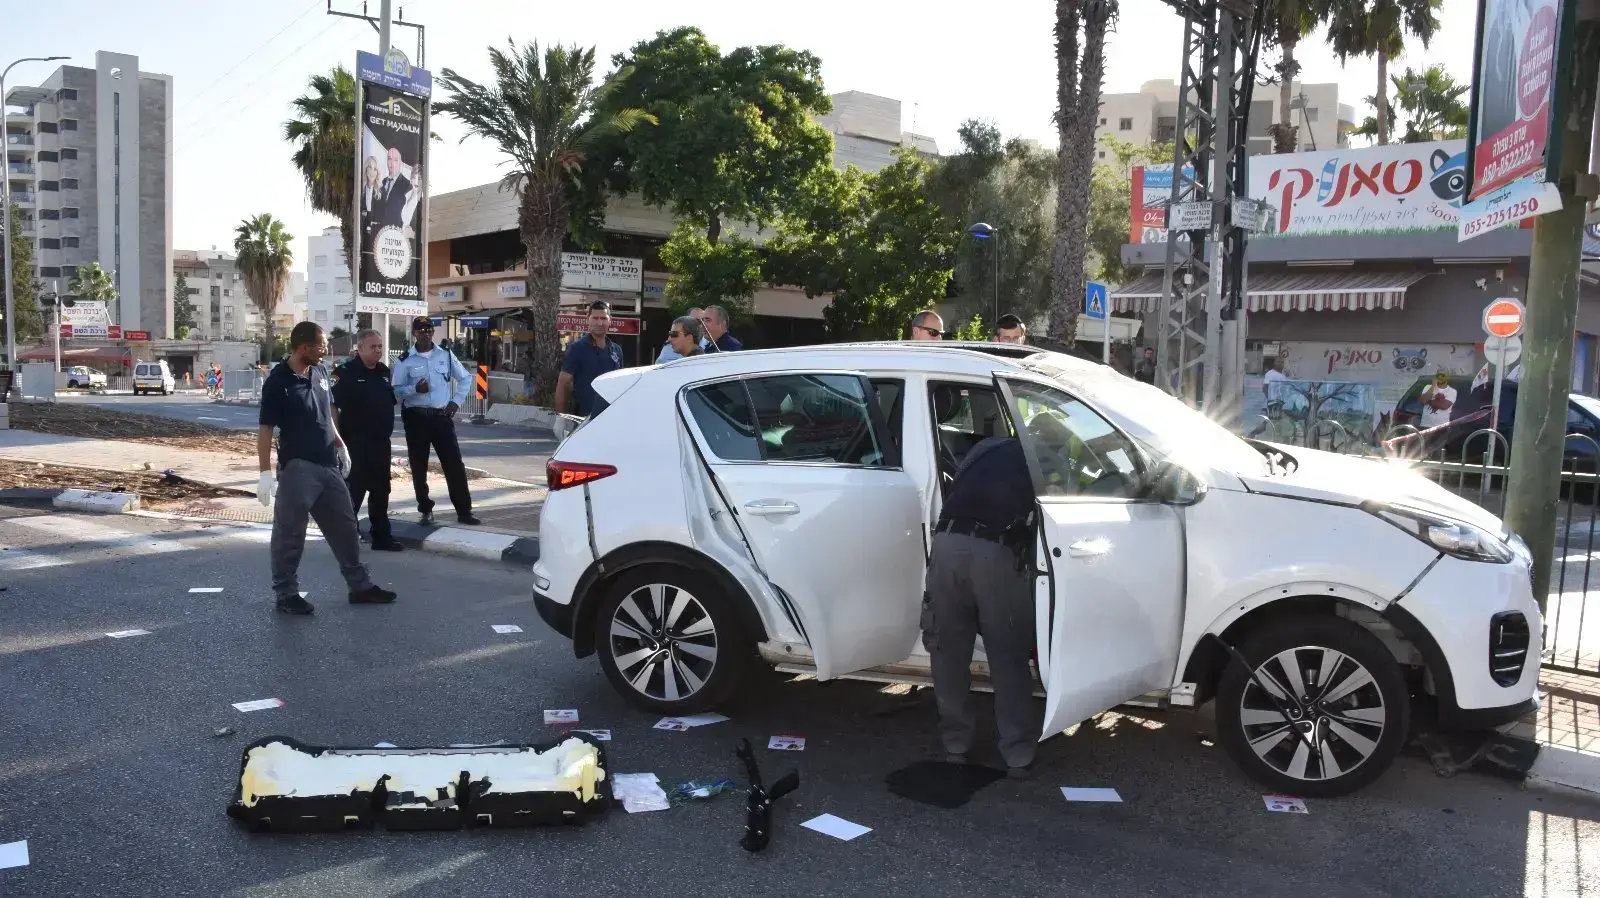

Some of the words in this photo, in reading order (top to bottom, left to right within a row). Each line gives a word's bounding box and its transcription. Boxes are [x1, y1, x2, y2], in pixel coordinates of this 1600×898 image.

[370, 116, 386, 125] GET
[1464, 197, 1539, 236] 055-2251250
[611, 265, 638, 274] משרד
[365, 281, 418, 296] 050-5077258
[362, 305, 422, 315] 055-2251250
